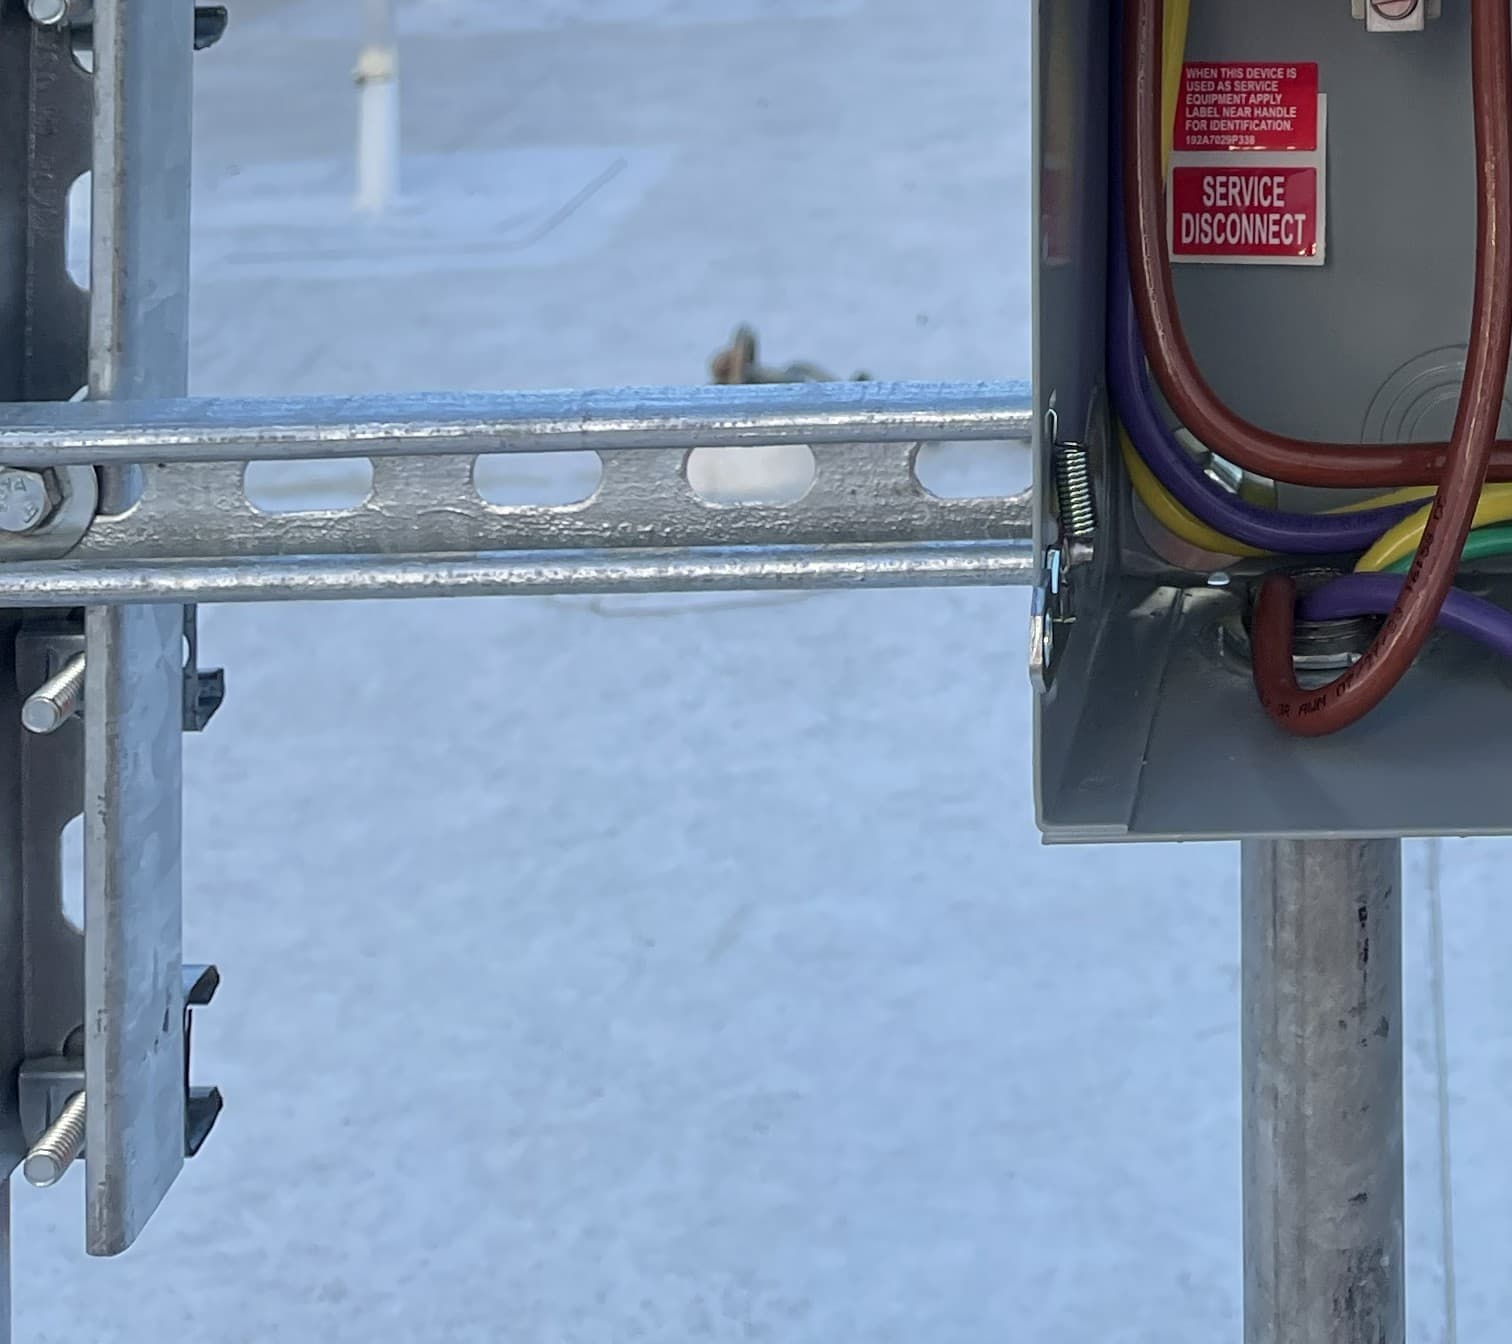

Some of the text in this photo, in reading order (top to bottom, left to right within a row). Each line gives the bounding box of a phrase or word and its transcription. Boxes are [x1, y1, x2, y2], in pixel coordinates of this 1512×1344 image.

[1185, 67, 1297, 79] WHEN THIS DEVICE IS
[1186, 80, 1279, 92] USED AS SERVICE
[1185, 93, 1283, 105] EQUIPMENT APPLY
[1185, 106, 1297, 118] LABEL NEAR HANDLE
[1185, 119, 1294, 131] FOR IDENTIFICATION.
[1202, 175, 1286, 207] SERVICE
[1181, 212, 1306, 245] DISCONNECT
